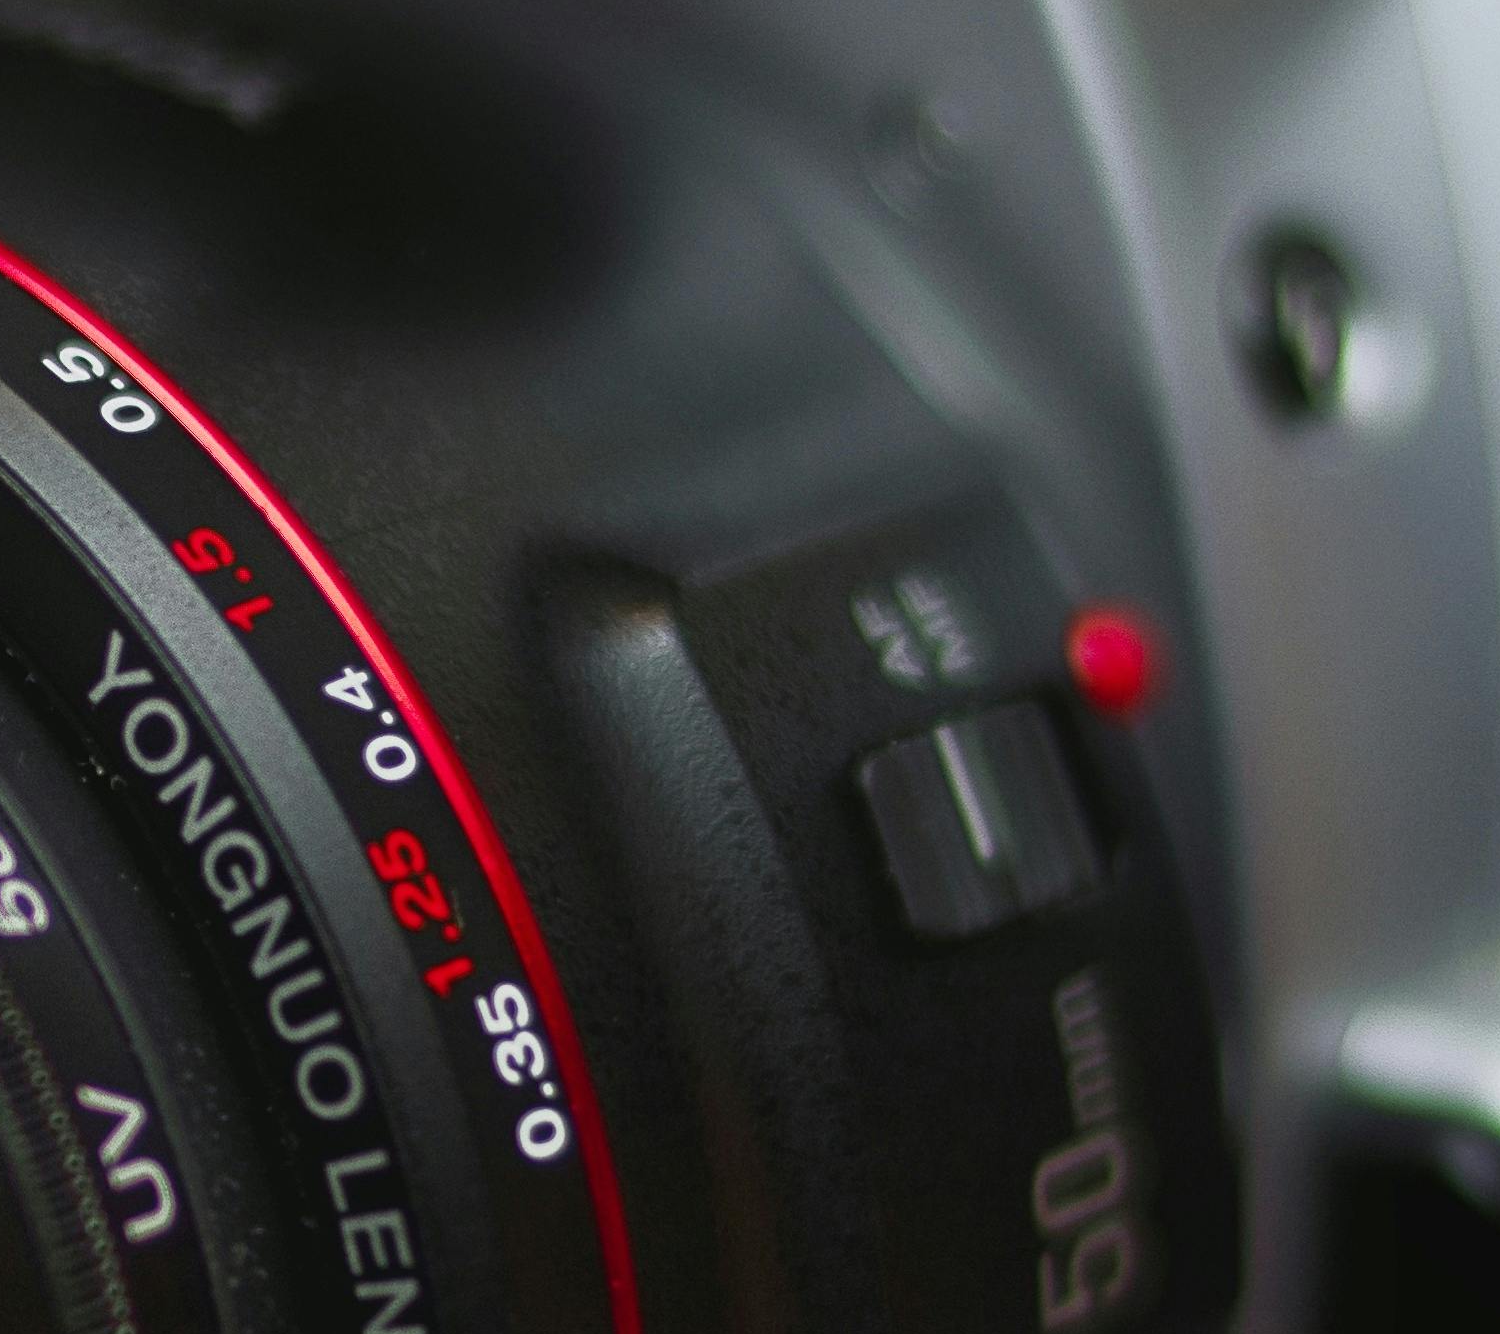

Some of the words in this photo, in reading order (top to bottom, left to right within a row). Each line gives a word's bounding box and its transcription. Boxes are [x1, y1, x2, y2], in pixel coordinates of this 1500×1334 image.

[42, 340, 158, 434] 0.5
[173, 527, 275, 632] 1.5
[324, 666, 418, 782] 0.4
[88, 630, 365, 1121] YONGNUO
[368, 829, 475, 998] 1.25
[475, 982, 569, 1161] 0.35
[76, 1084, 178, 1242] UV
